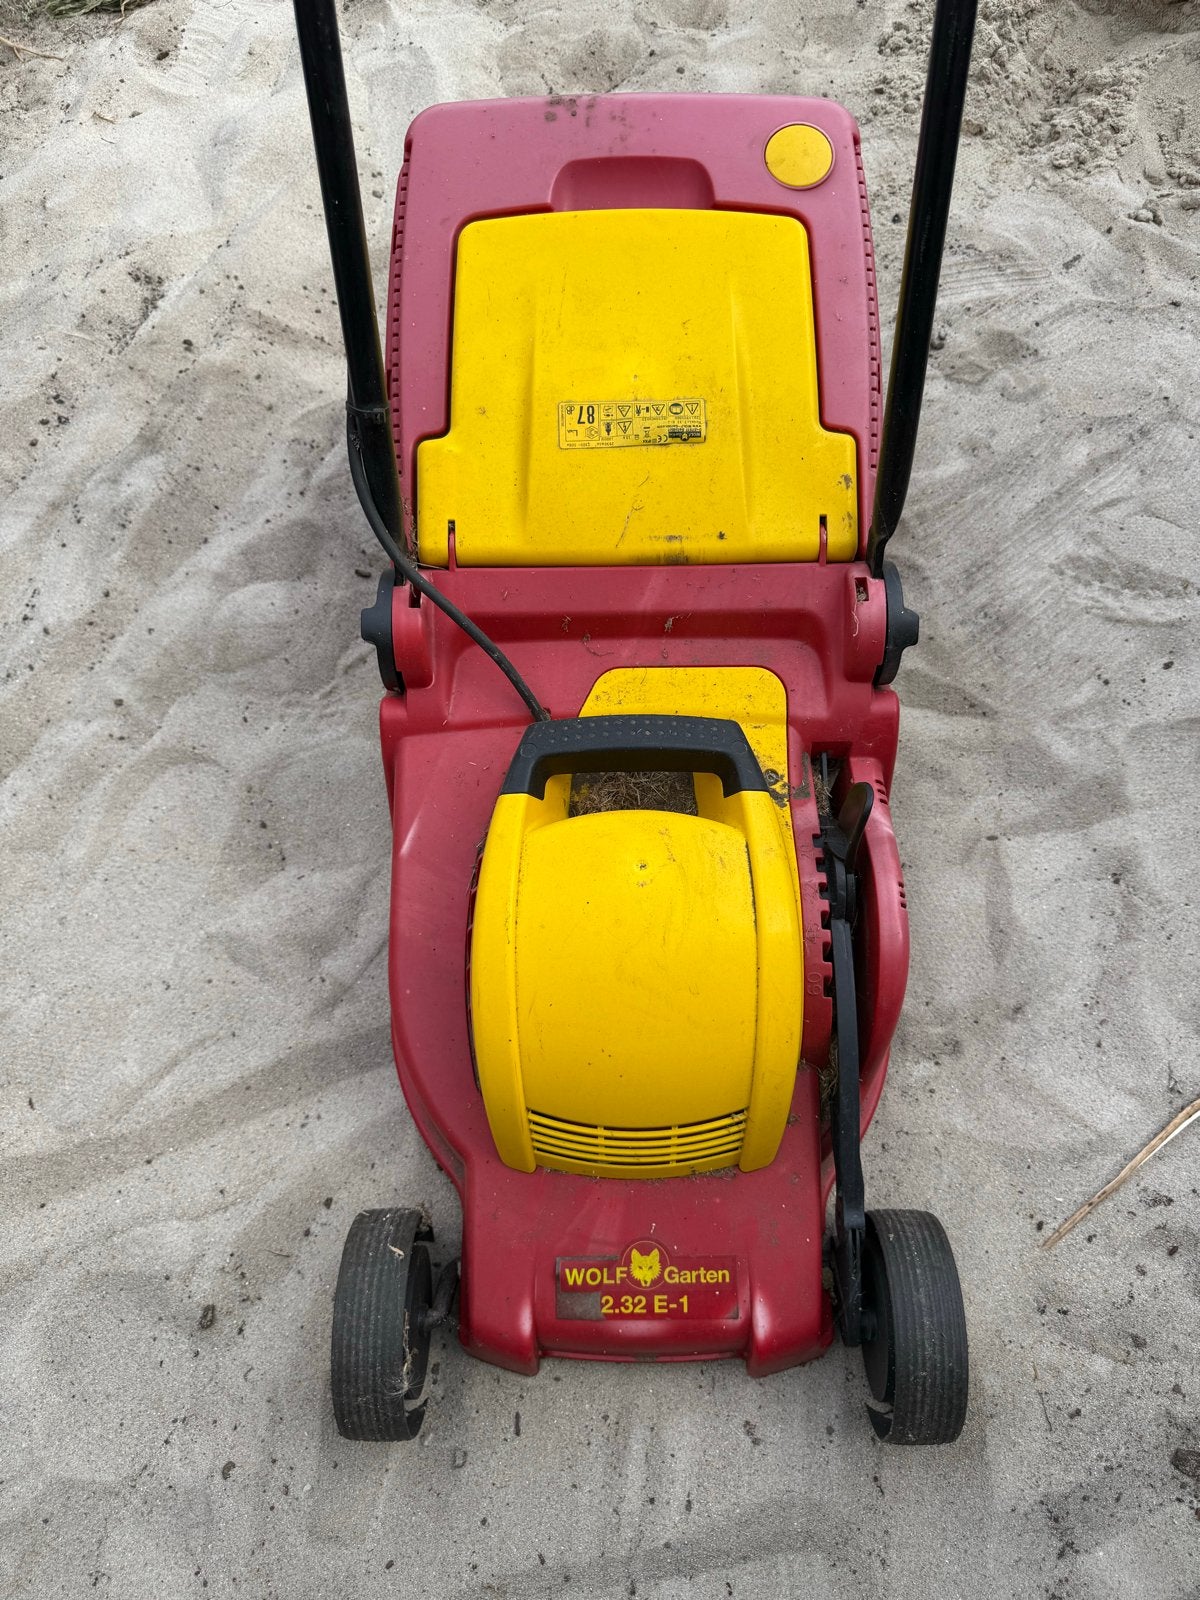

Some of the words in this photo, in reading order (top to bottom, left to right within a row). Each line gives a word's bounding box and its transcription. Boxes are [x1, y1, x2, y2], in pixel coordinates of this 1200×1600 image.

[577, 406, 594, 424] 87
[807, 972, 822, 996] 60
[565, 1266, 628, 1286] WOLF
[664, 1266, 730, 1284] Garten
[601, 1295, 647, 1314] 2.32
[654, 1295, 688, 1313] E-1
